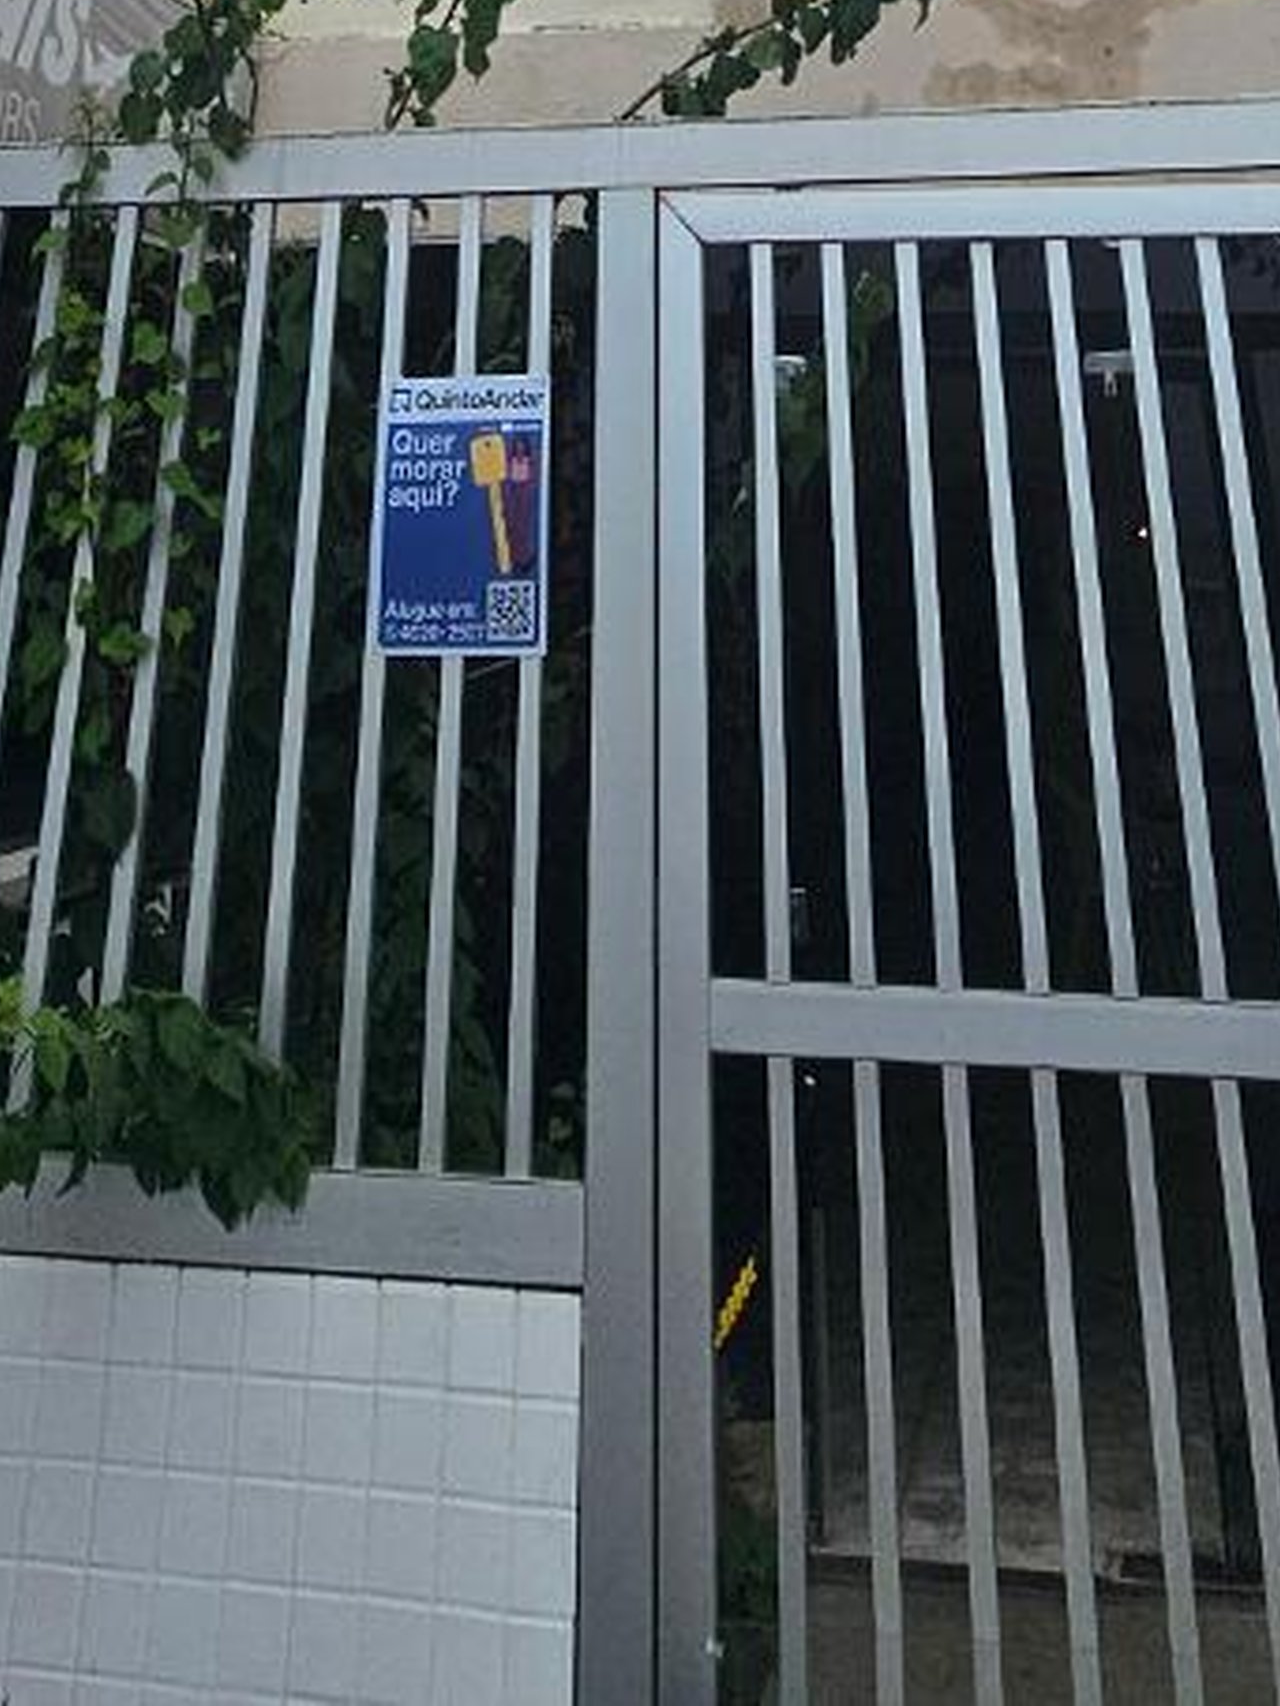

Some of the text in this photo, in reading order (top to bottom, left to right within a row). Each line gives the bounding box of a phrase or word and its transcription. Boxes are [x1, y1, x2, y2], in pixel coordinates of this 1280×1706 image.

[415, 389, 544, 410] QuintoAndar
[392, 429, 456, 455] Quer
[390, 459, 466, 481] morar
[388, 479, 458, 513] aqui?
